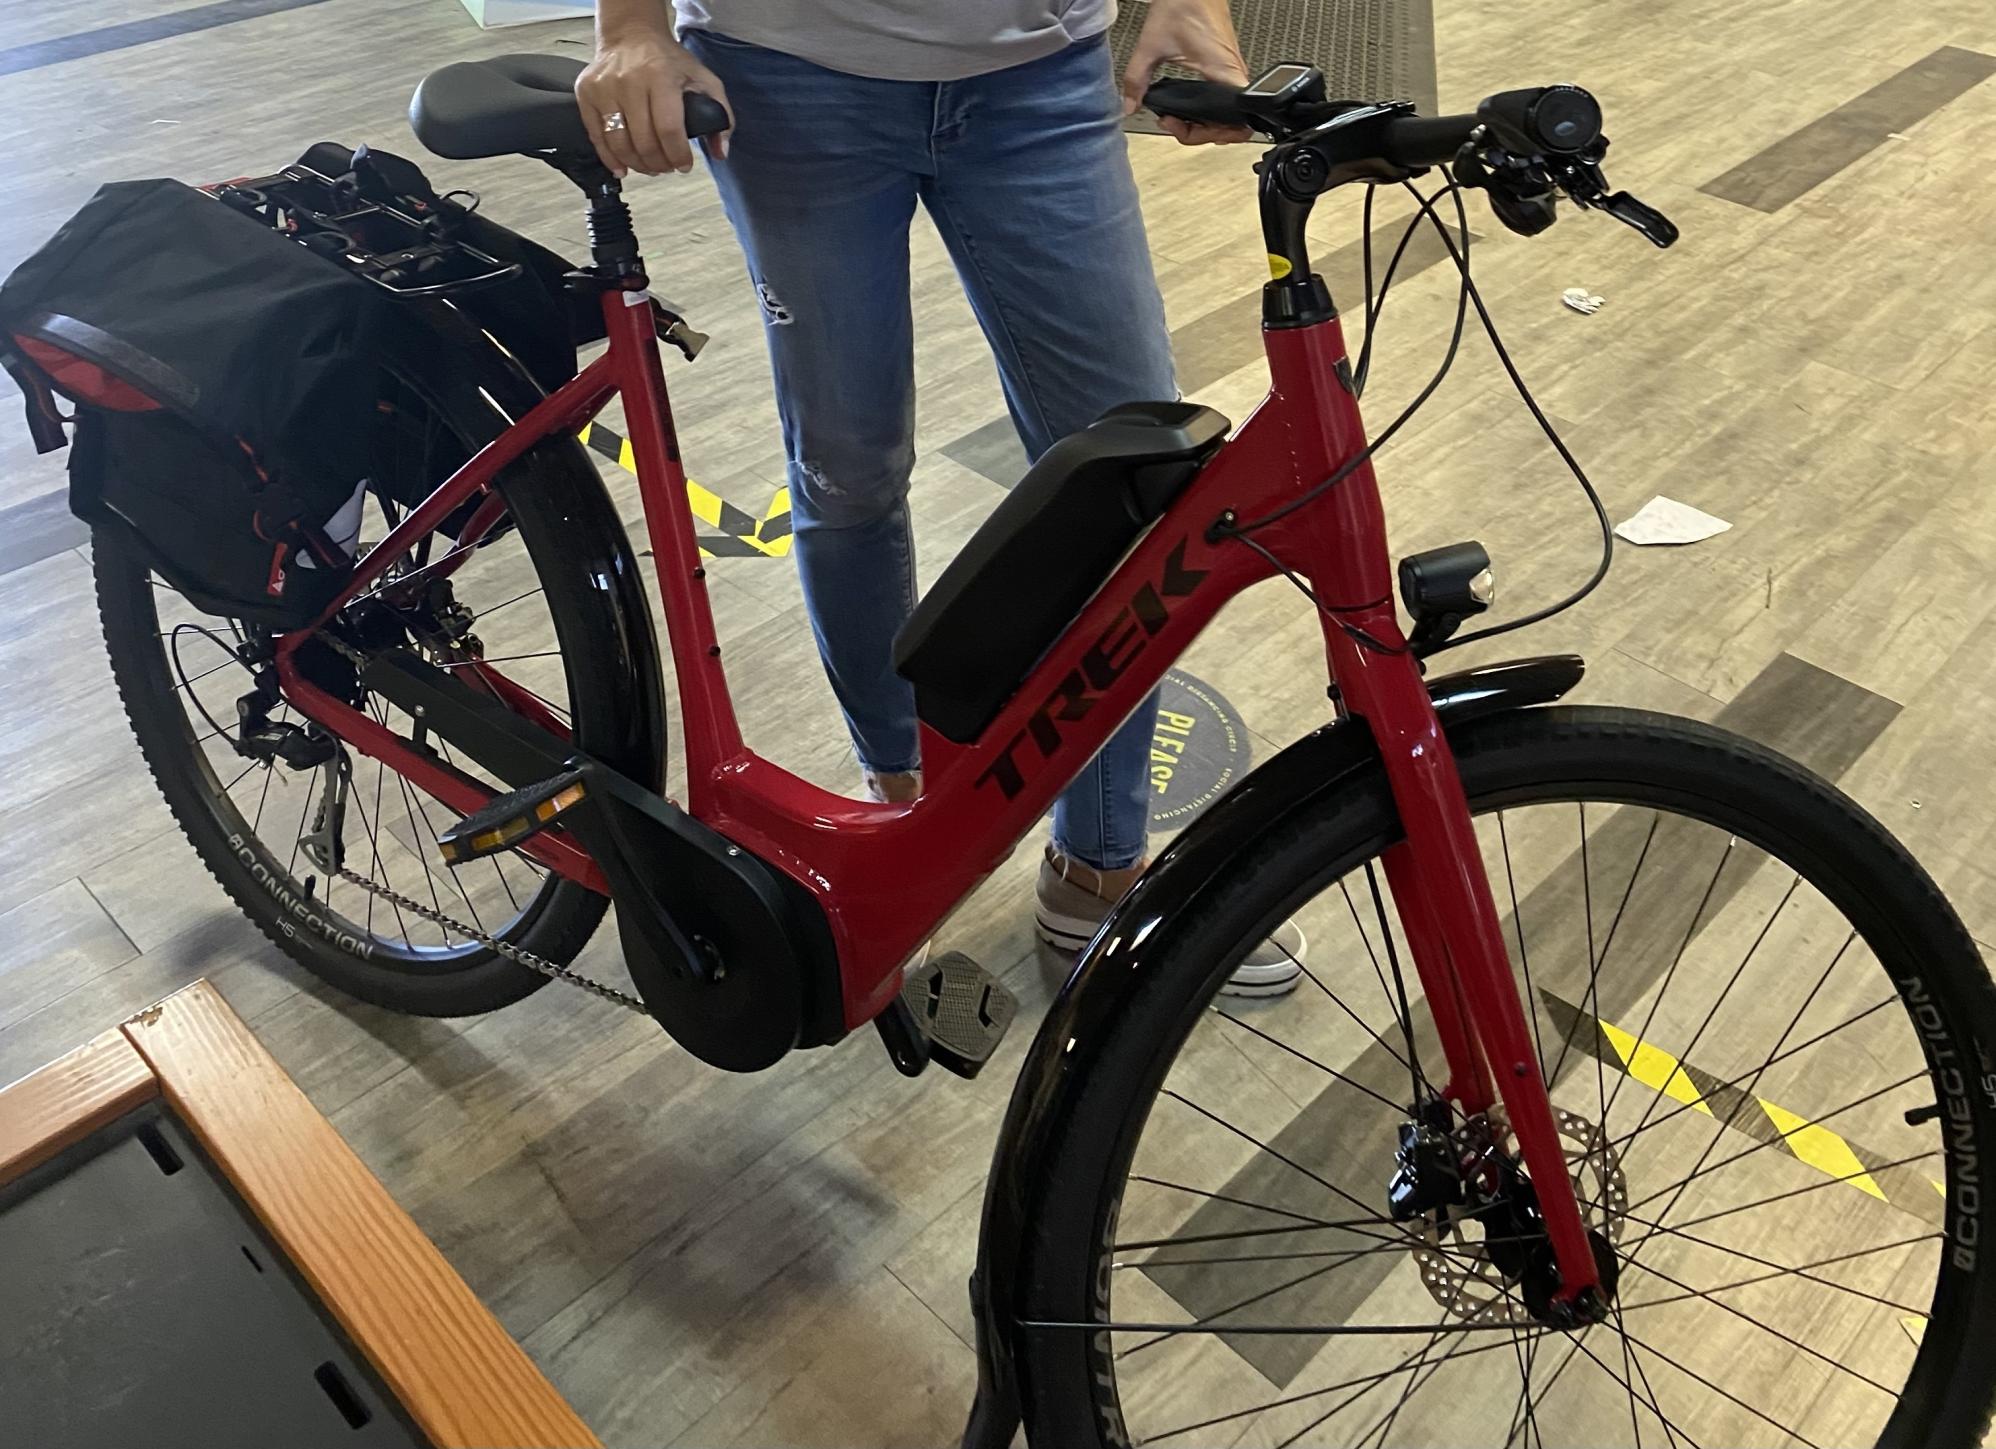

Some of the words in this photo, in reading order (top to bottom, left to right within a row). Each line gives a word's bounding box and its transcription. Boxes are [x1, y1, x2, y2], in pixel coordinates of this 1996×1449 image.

[974, 534, 1211, 800] TREK
[238, 846, 373, 960] CONNECTION
[1902, 977, 1979, 1254] CONNECTION
